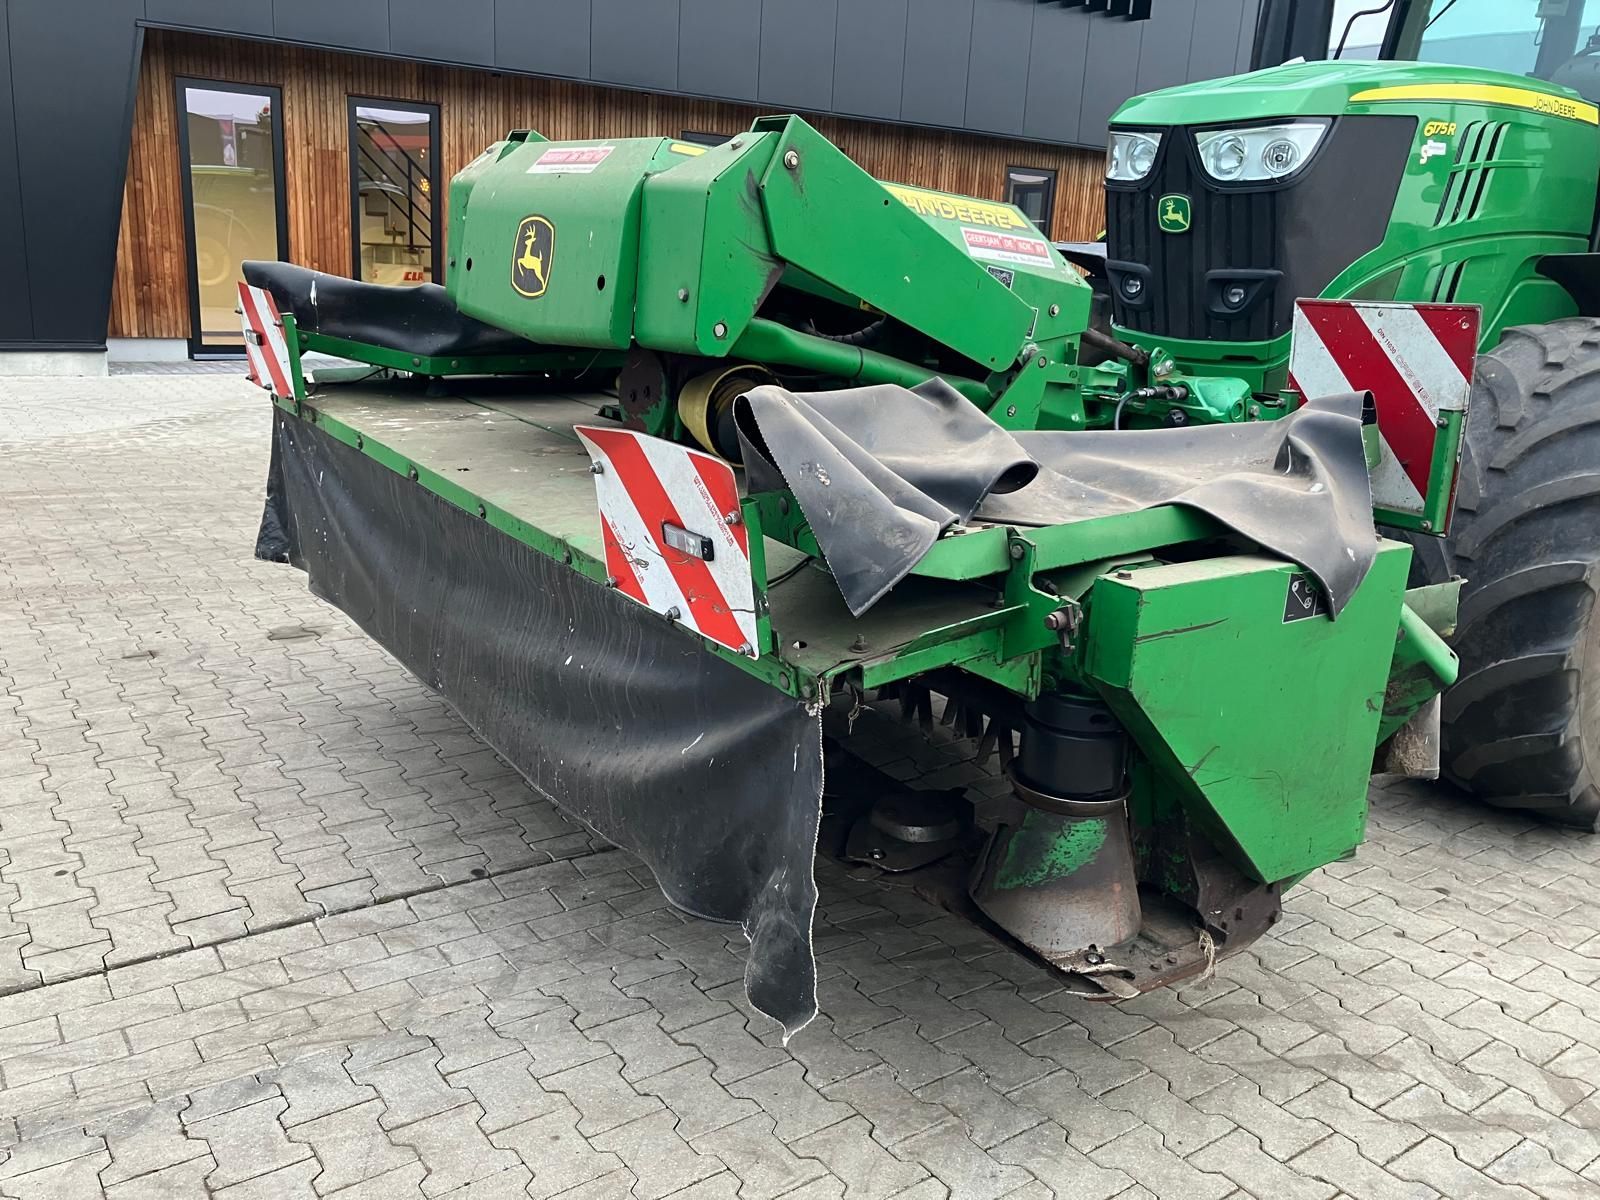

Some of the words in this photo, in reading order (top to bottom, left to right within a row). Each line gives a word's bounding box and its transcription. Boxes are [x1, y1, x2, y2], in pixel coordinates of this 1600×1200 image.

[1533, 95, 1553, 111] JOHN
[1554, 99, 1576, 117] DEERE
[936, 197, 1013, 230] DEERE
[1377, 328, 1386, 340] DIN
[1384, 338, 1397, 354] 11030
